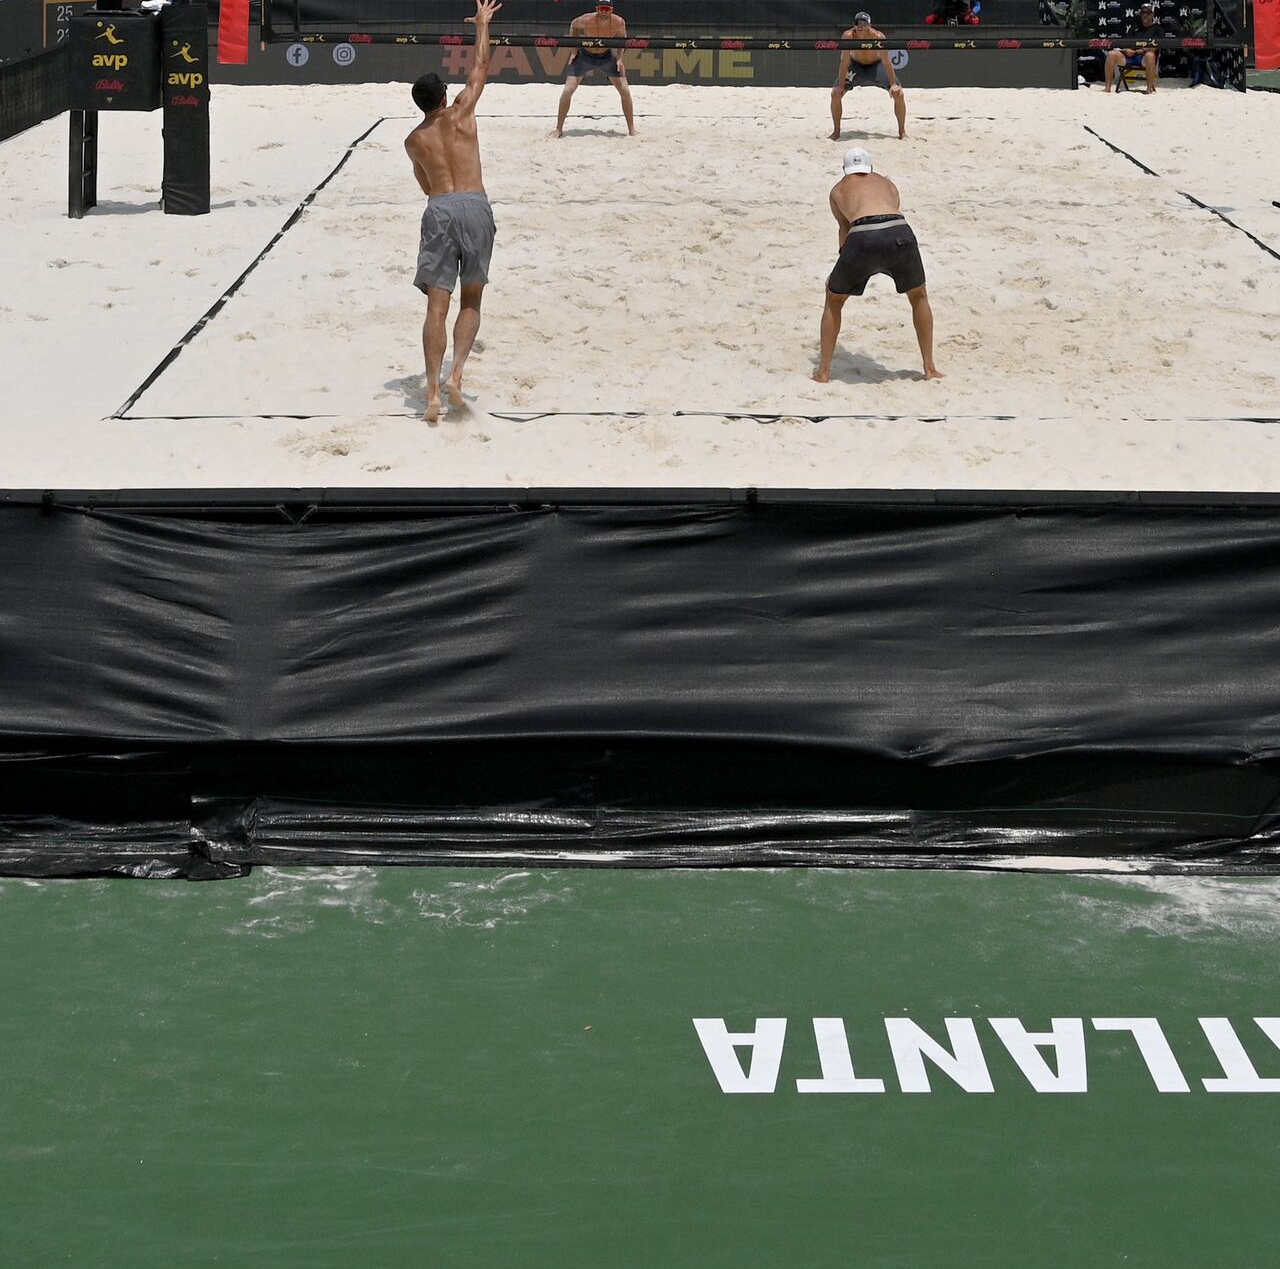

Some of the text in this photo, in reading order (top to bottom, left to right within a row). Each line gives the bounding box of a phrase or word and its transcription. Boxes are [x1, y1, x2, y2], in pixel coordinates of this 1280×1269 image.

[57, 5, 73, 22] 25
[92, 54, 128, 71] avp
[167, 72, 203, 89] avp
